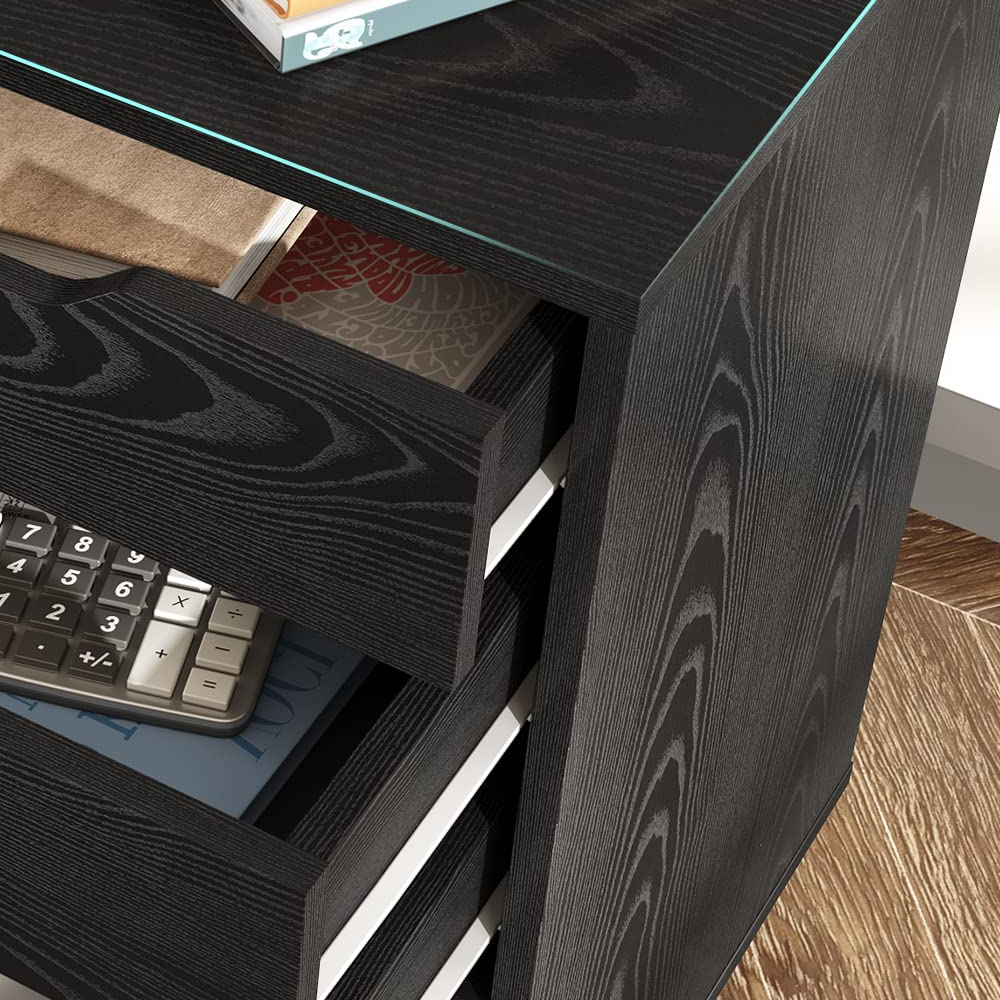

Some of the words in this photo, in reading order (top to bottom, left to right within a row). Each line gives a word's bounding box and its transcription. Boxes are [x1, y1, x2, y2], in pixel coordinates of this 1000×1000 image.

[23, 524, 42, 541] 7
[74, 535, 93, 552] 8
[6, 557, 27, 574] 4
[60, 568, 80, 585] 5
[115, 581, 134, 597] 6
[45, 603, 65, 620] 2
[100, 615, 120, 632] 3
